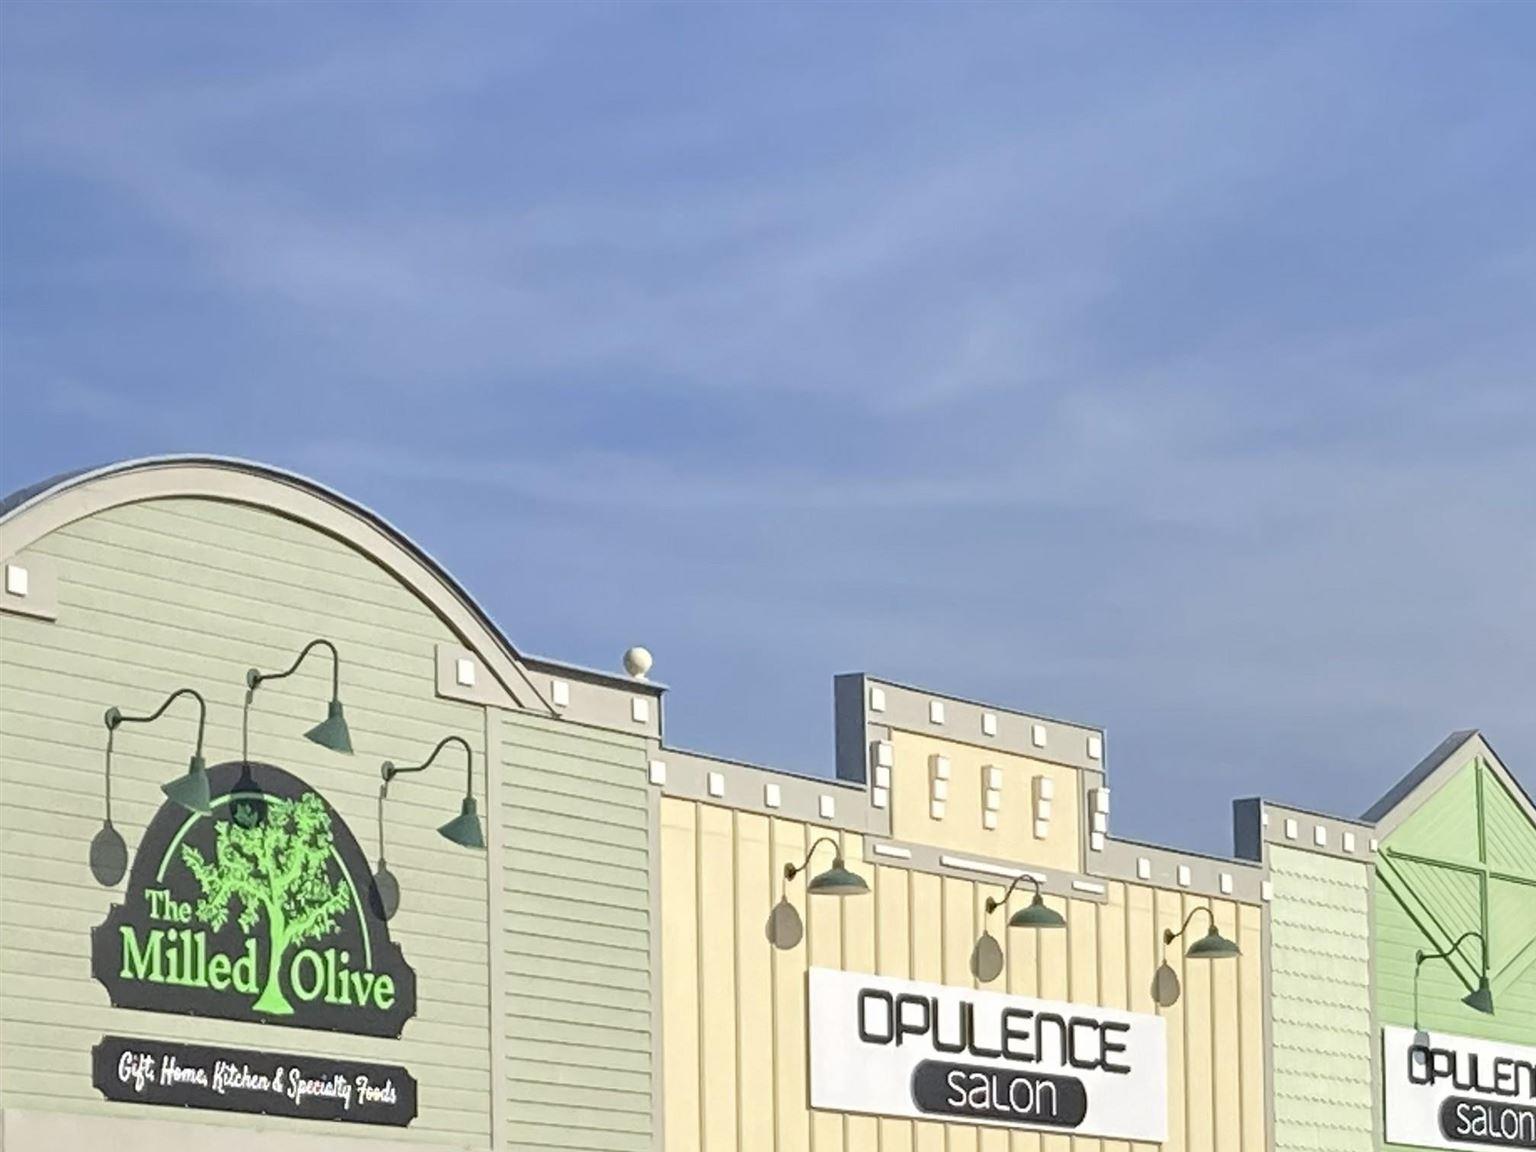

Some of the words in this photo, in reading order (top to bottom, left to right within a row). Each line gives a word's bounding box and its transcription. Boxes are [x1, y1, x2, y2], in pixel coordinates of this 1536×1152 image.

[144, 888, 192, 924] The
[119, 925, 260, 995] Milled
[290, 948, 395, 1010] Olive
[857, 987, 1131, 1075] OPULENCE
[212, 1060, 270, 1095] Kitchen
[272, 1067, 283, 1091] &
[287, 1069, 352, 1109] Specialty
[355, 1075, 397, 1104] Foods
